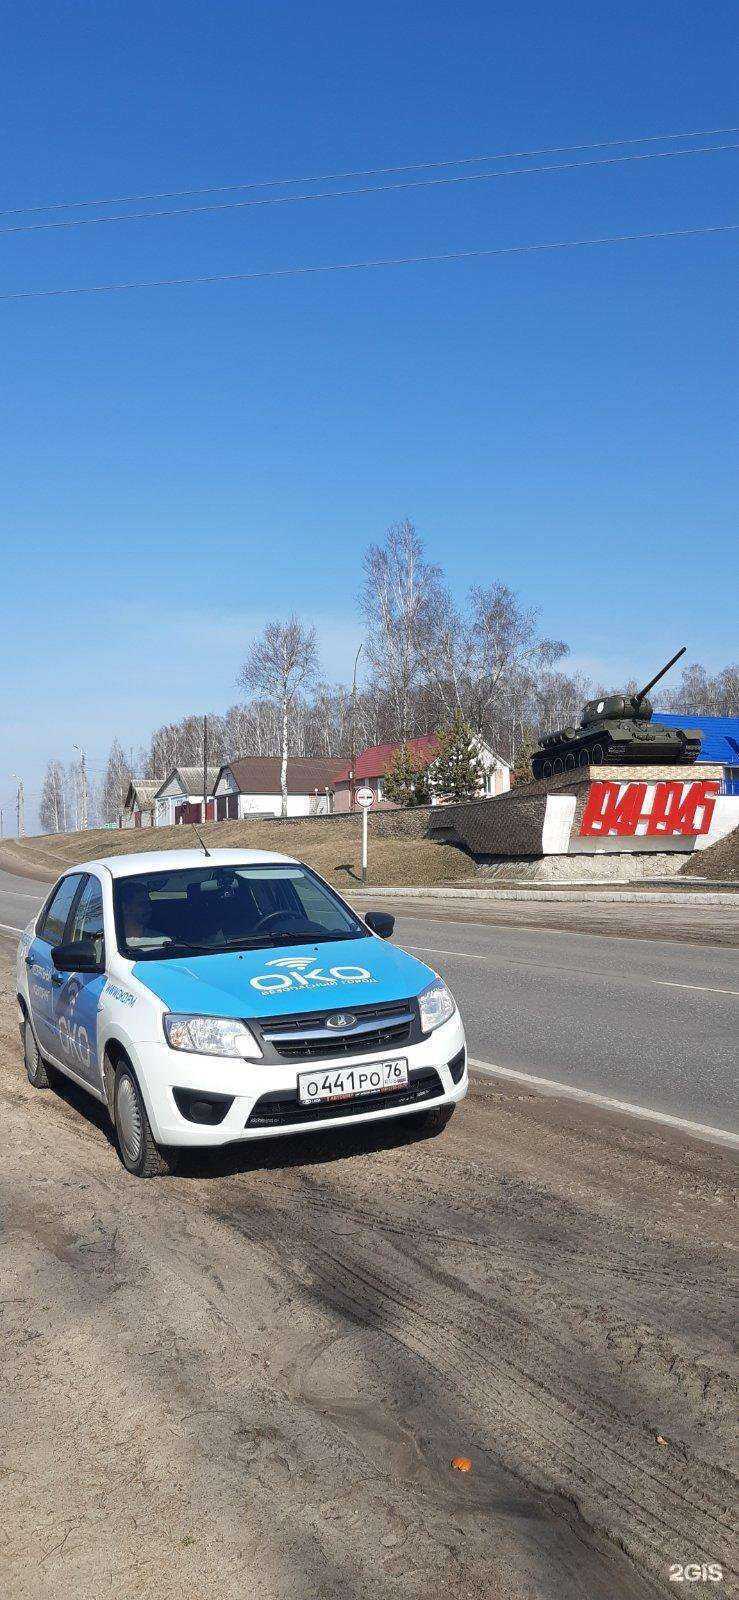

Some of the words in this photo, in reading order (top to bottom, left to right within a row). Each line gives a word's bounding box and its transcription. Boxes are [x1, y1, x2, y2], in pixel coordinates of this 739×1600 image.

[579, 781, 720, 836] 1941-1945
[250, 966, 371, 990] ОКО
[59, 1016, 91, 1068] ОКО
[385, 1062, 402, 1079] 76
